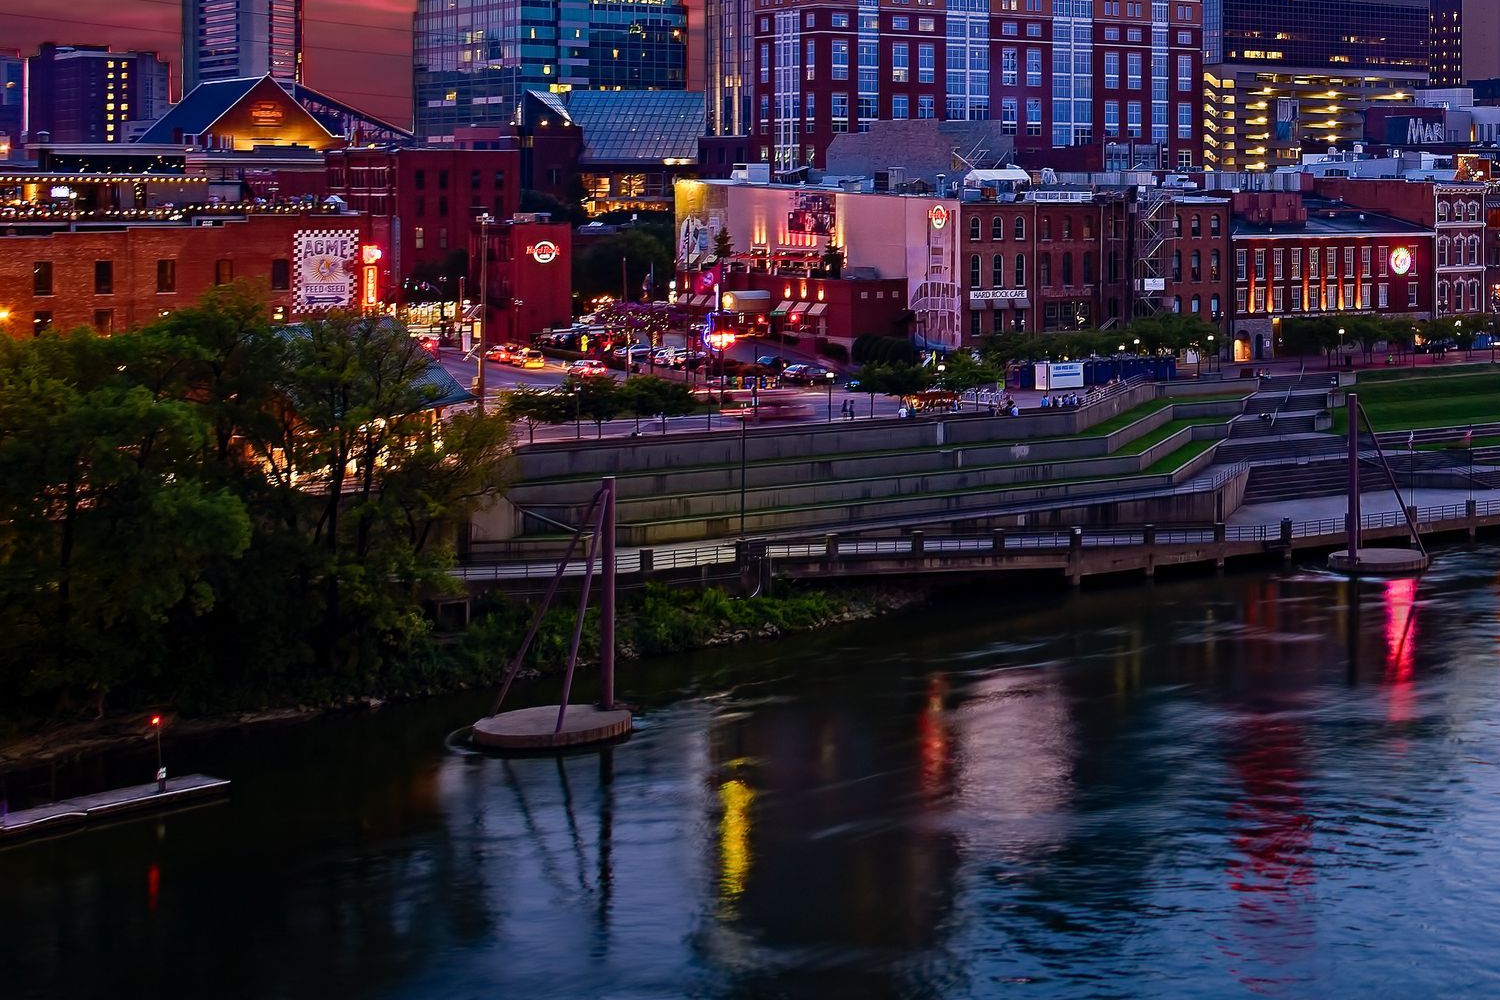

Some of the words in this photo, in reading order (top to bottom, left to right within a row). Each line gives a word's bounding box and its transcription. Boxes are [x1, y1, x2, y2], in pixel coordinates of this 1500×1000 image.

[303, 239, 348, 260] ACME
[305, 285, 324, 293] FEED
[327, 285, 346, 293] SEED
[973, 291, 991, 299] HARD
[991, 290, 1010, 298] ROCK
